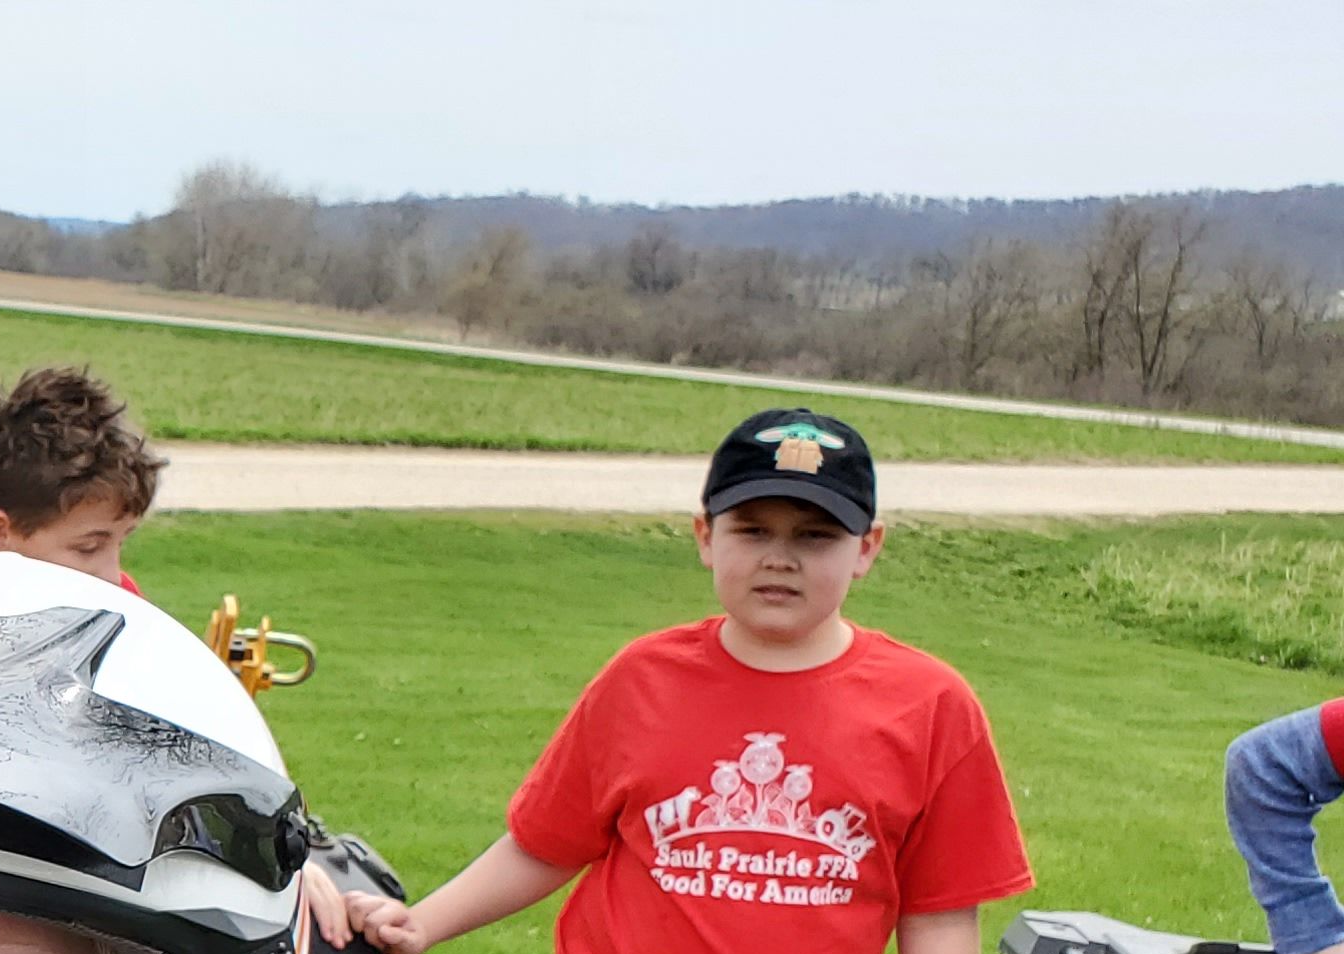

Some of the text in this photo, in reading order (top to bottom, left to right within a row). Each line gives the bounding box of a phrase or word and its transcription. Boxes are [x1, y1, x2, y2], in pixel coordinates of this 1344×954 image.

[655, 842, 859, 881] Sauk Prairie FFA
[711, 874, 757, 901] For
